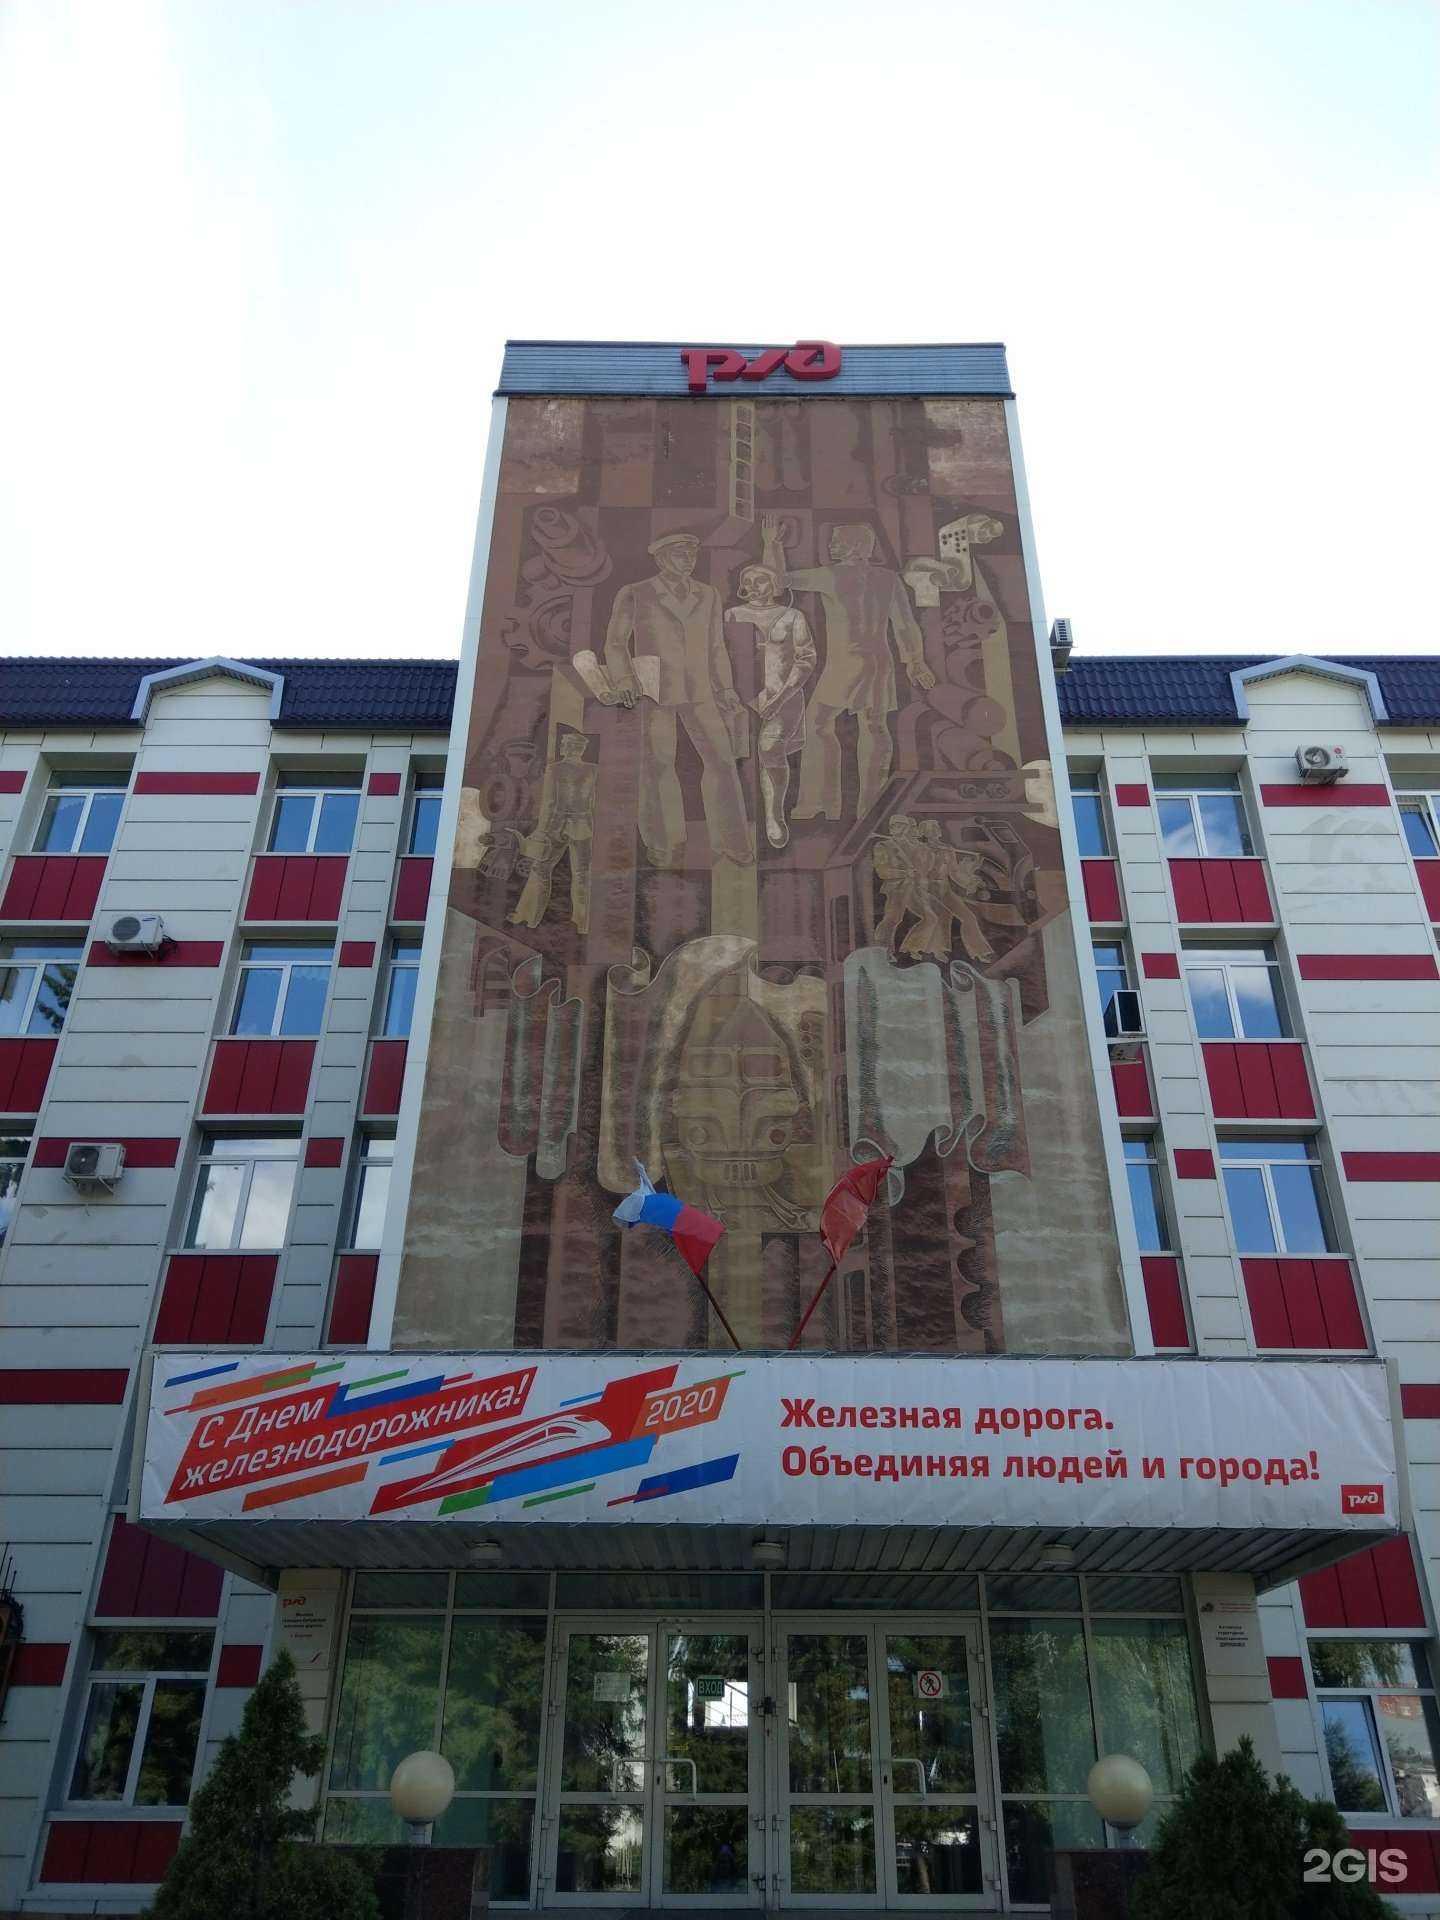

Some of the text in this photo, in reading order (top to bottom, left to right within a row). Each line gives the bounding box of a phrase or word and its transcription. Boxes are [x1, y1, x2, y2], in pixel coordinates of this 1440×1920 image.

[198, 1397, 326, 1449] С Днем
[645, 1386, 717, 1427] 2020
[780, 1398, 1114, 1437] Железная дорога.
[179, 1373, 530, 1490] железнодорожника!
[782, 1445, 1320, 1488] Объединяя людей и города!
[698, 1680, 724, 1695] ВХОД
